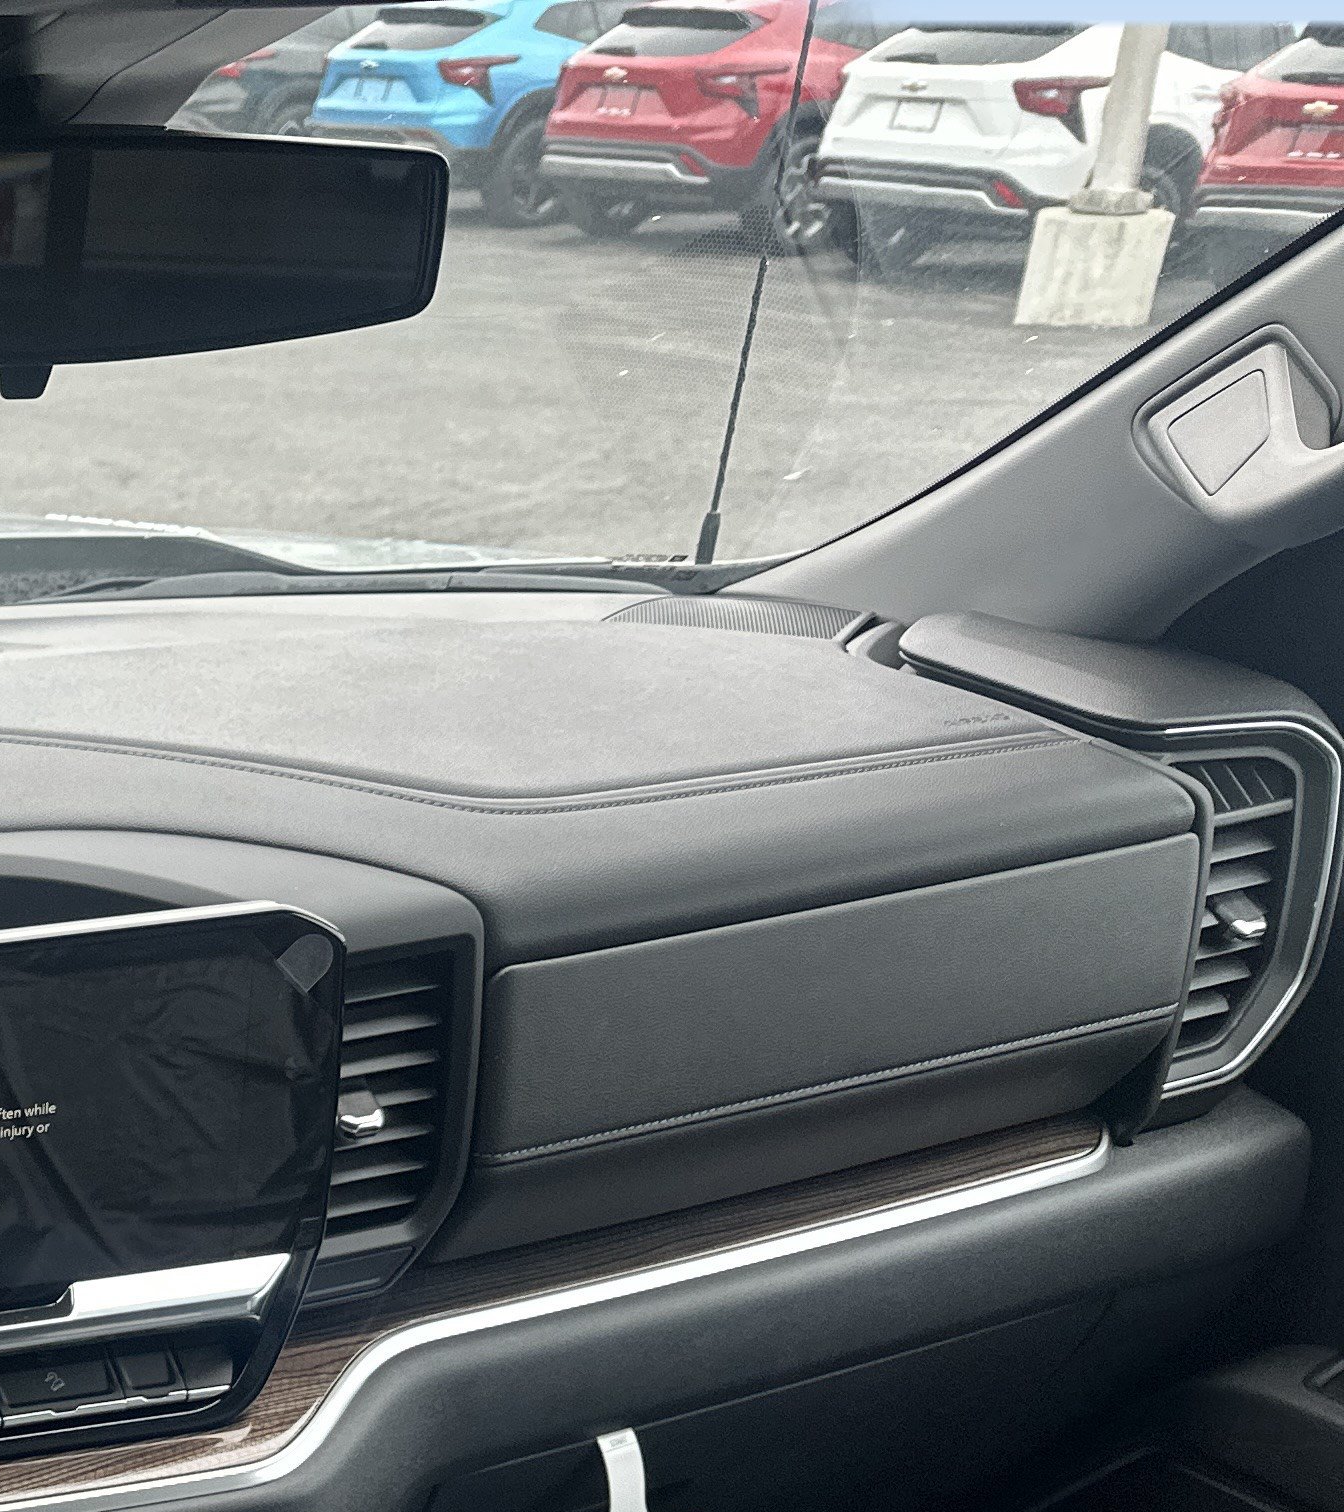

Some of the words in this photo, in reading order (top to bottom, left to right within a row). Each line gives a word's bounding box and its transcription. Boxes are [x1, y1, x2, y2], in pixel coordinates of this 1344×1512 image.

[24, 1101, 56, 1117] while
[0, 1125, 34, 1140] injury
[36, 1122, 51, 1133] or
